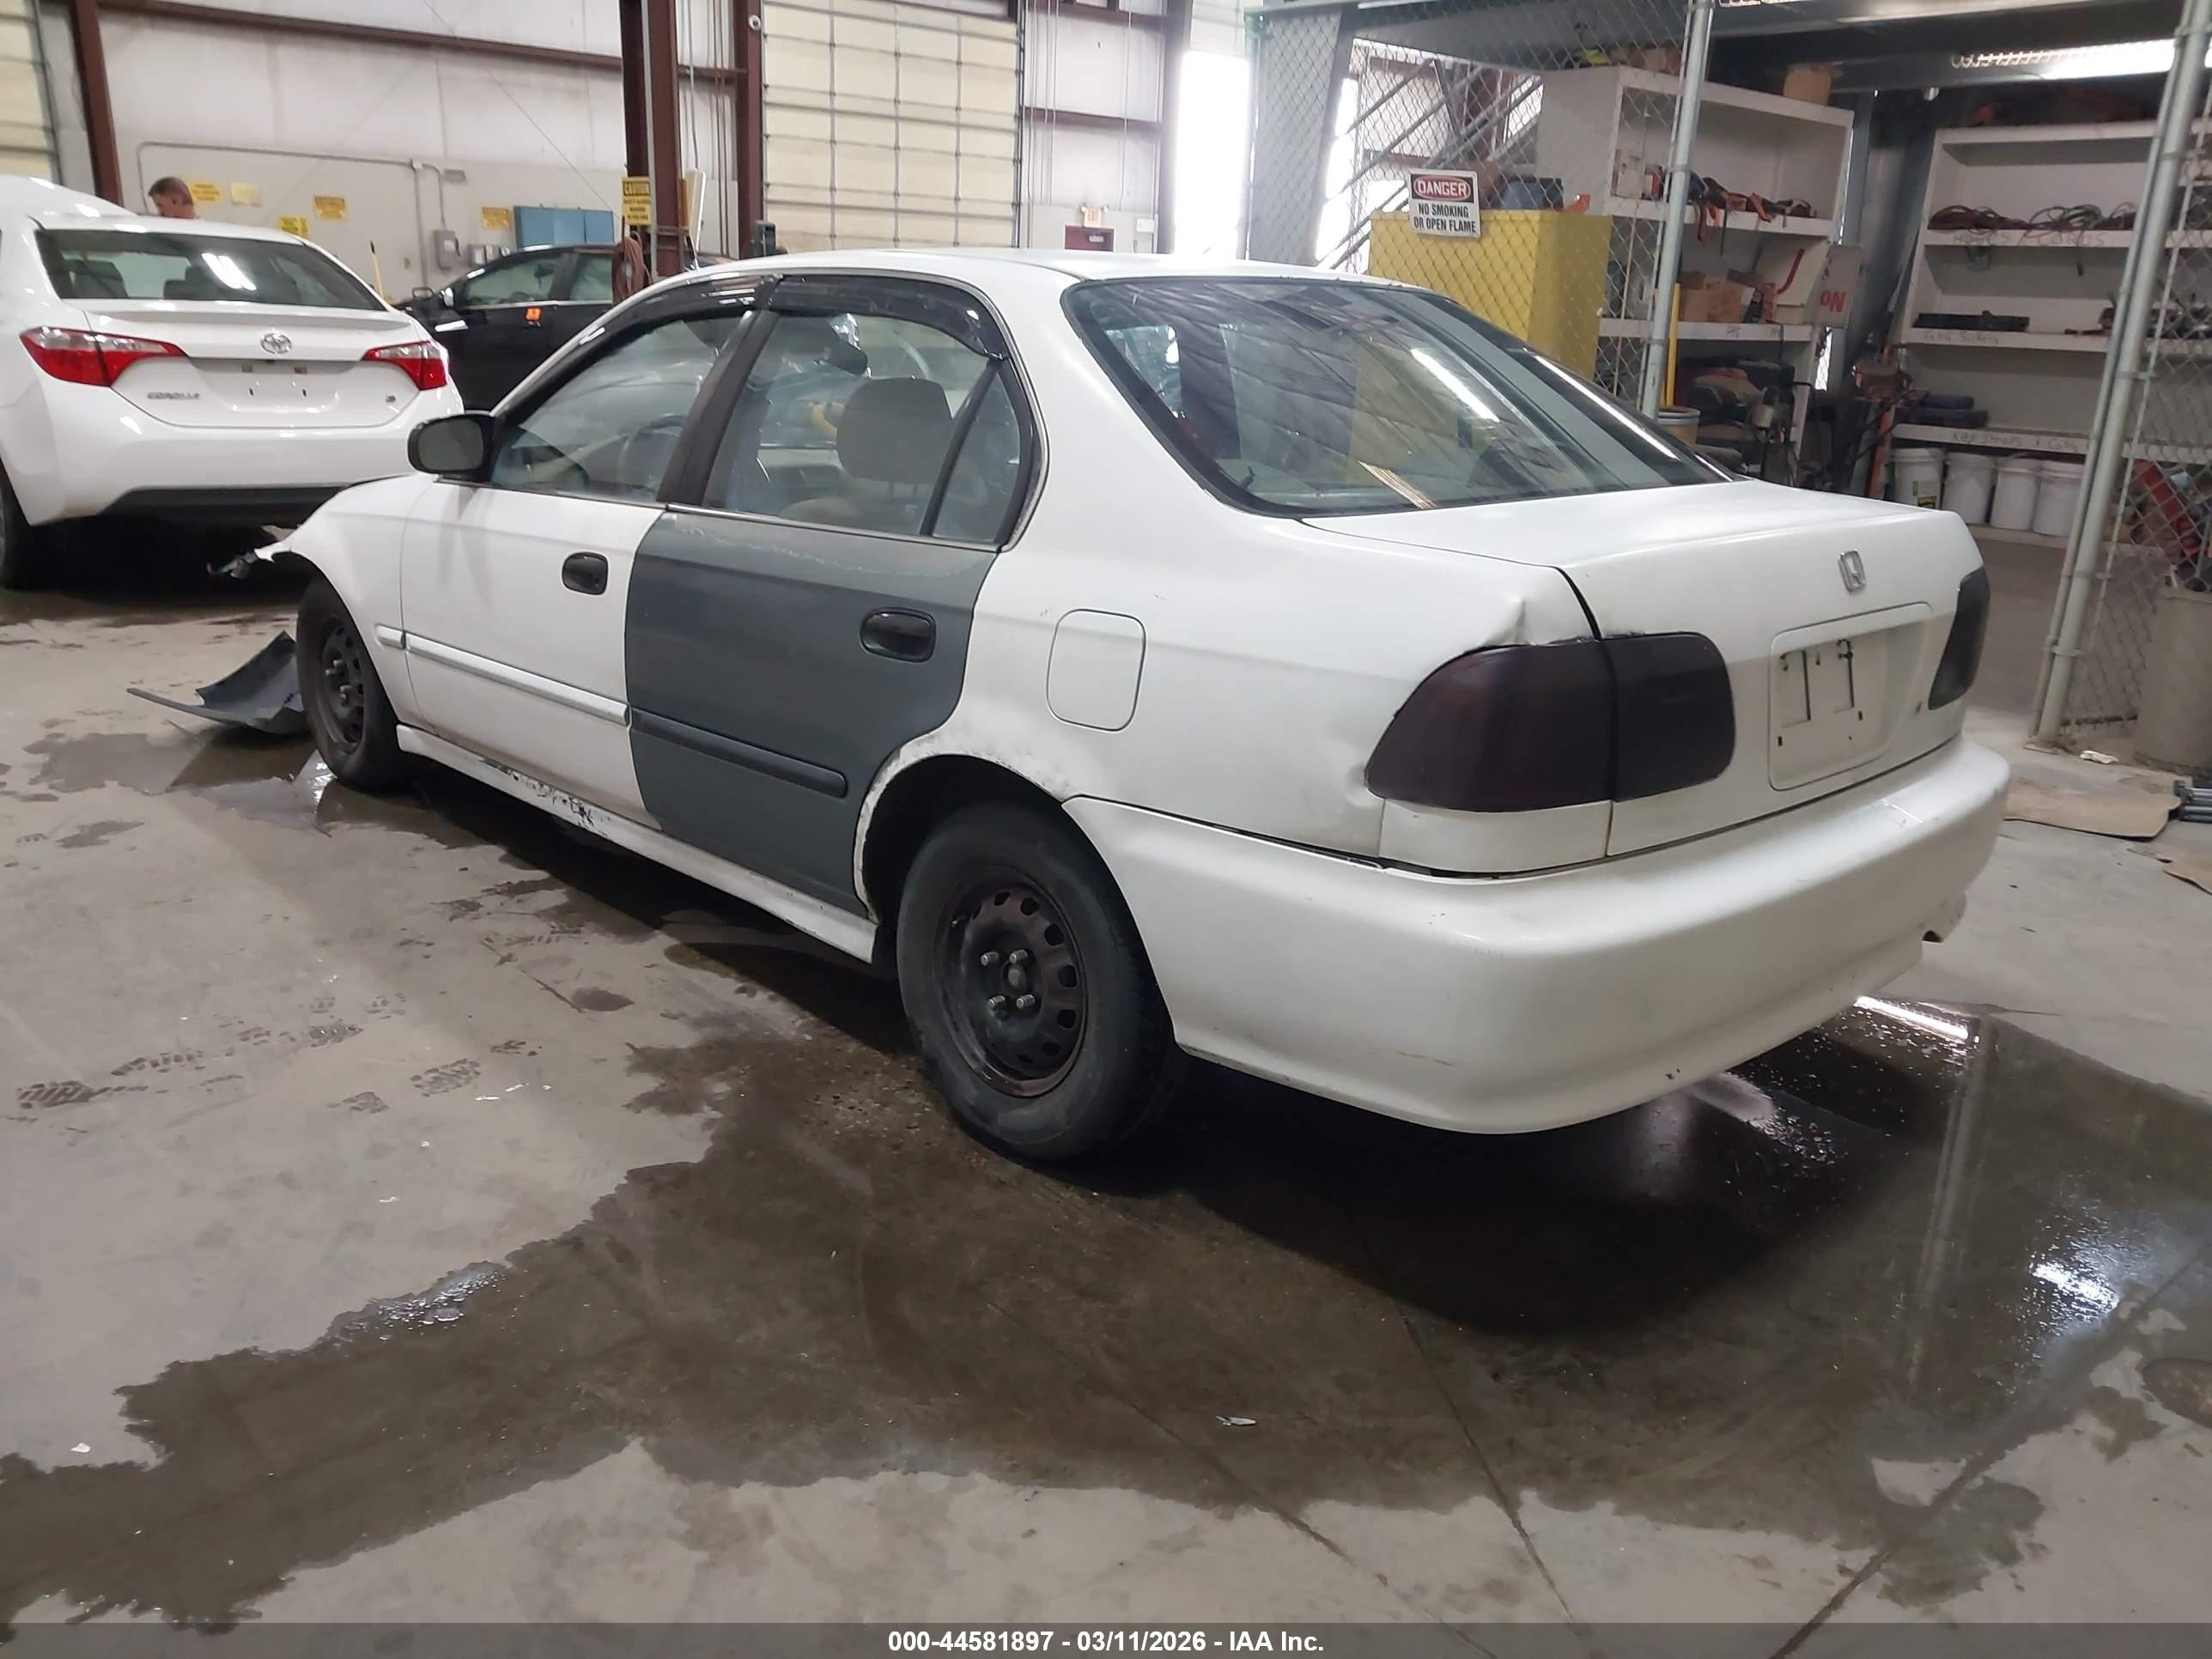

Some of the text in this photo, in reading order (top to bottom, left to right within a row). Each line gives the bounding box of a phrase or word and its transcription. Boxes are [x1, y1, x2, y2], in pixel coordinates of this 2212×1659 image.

[624, 182, 649, 195] CAUN
[1418, 180, 1467, 197] DANGER
[1419, 203, 1469, 218] NO SMOKING
[1413, 216, 1476, 234] OR OPEN FLAME
